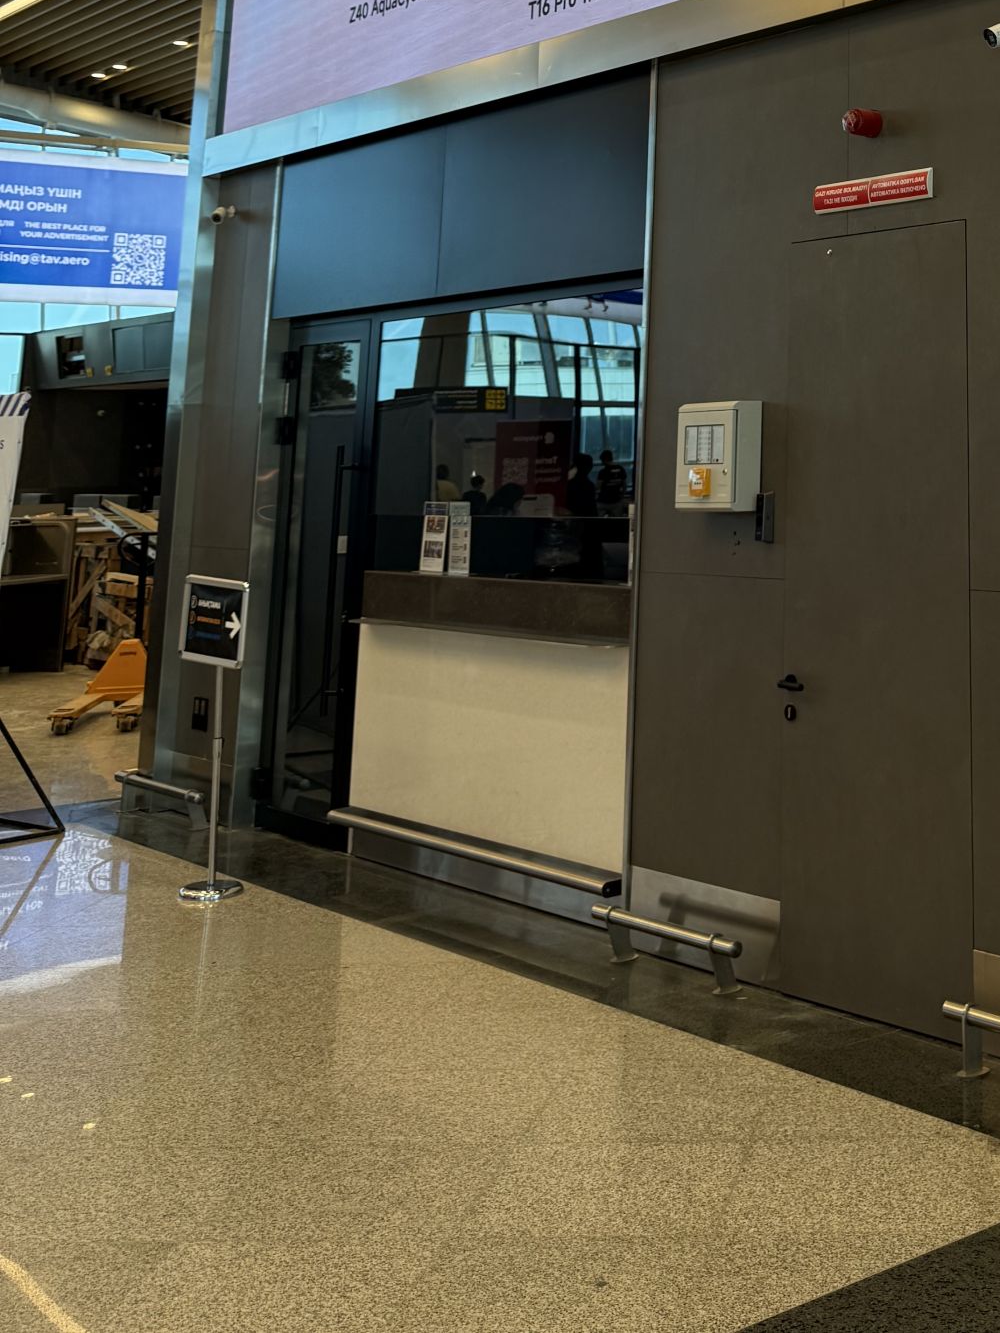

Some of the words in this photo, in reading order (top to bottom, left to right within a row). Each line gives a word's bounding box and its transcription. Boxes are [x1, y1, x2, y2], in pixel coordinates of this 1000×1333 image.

[349, 2, 368, 23] Z40
[26, 201, 67, 213] ОРЫН
[20, 230, 43, 238] YOUR
[44, 232, 109, 242] ADVERTISEMENT
